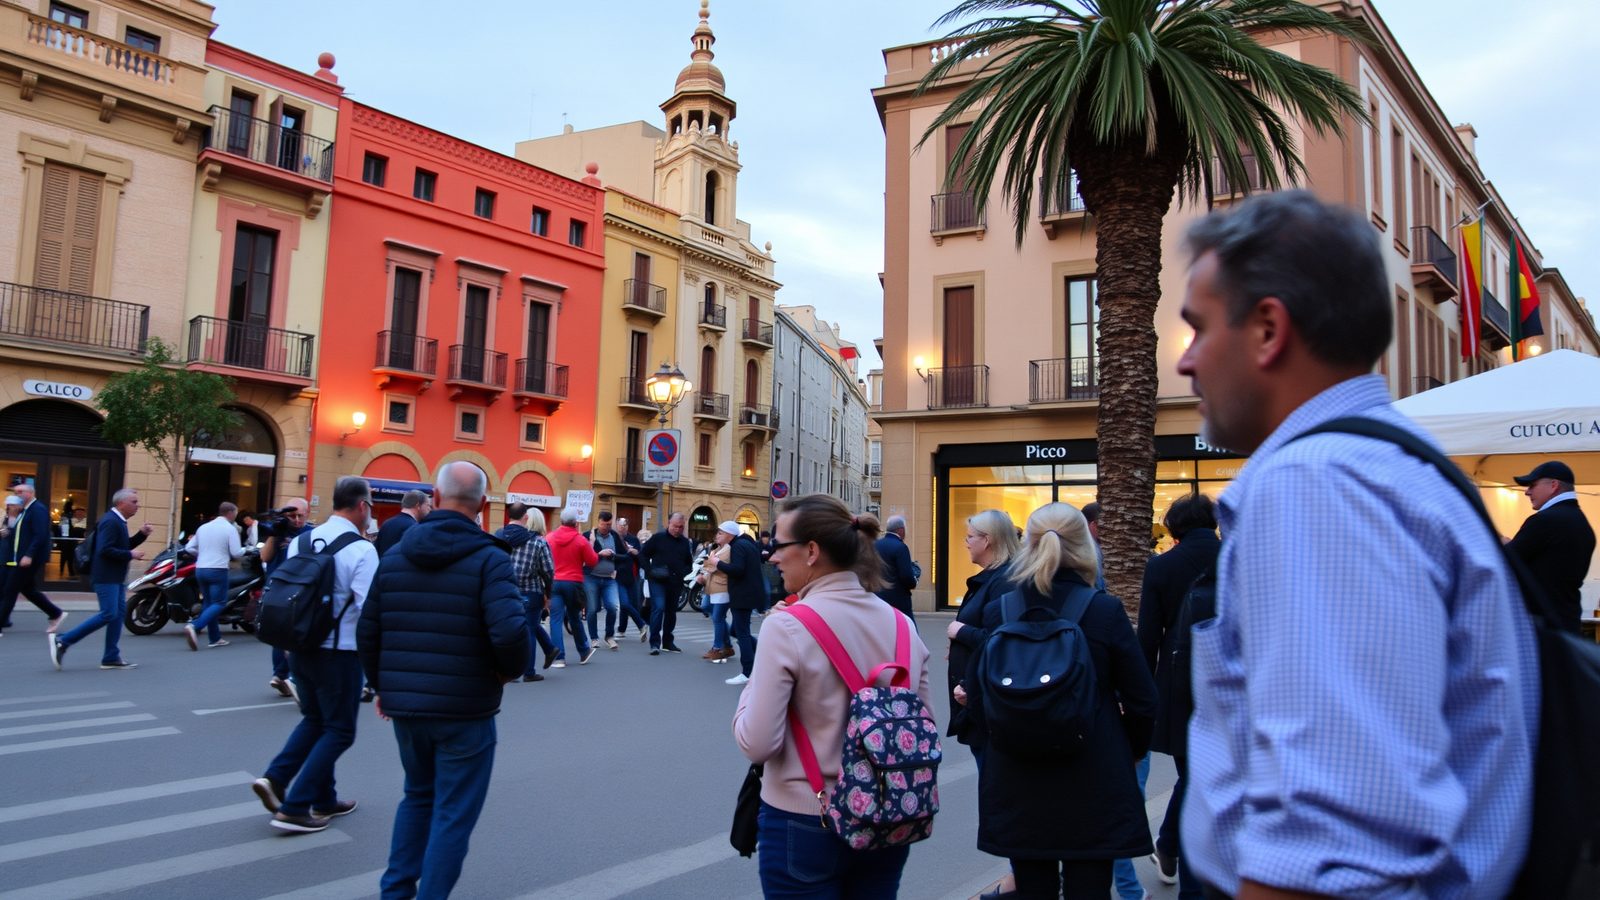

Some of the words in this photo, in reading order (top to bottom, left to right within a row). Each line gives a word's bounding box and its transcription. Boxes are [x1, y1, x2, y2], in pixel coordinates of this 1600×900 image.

[35, 382, 82, 398] CALCO
[1510, 422, 1582, 438] CUTCOU
[1026, 445, 1066, 459] Picco
